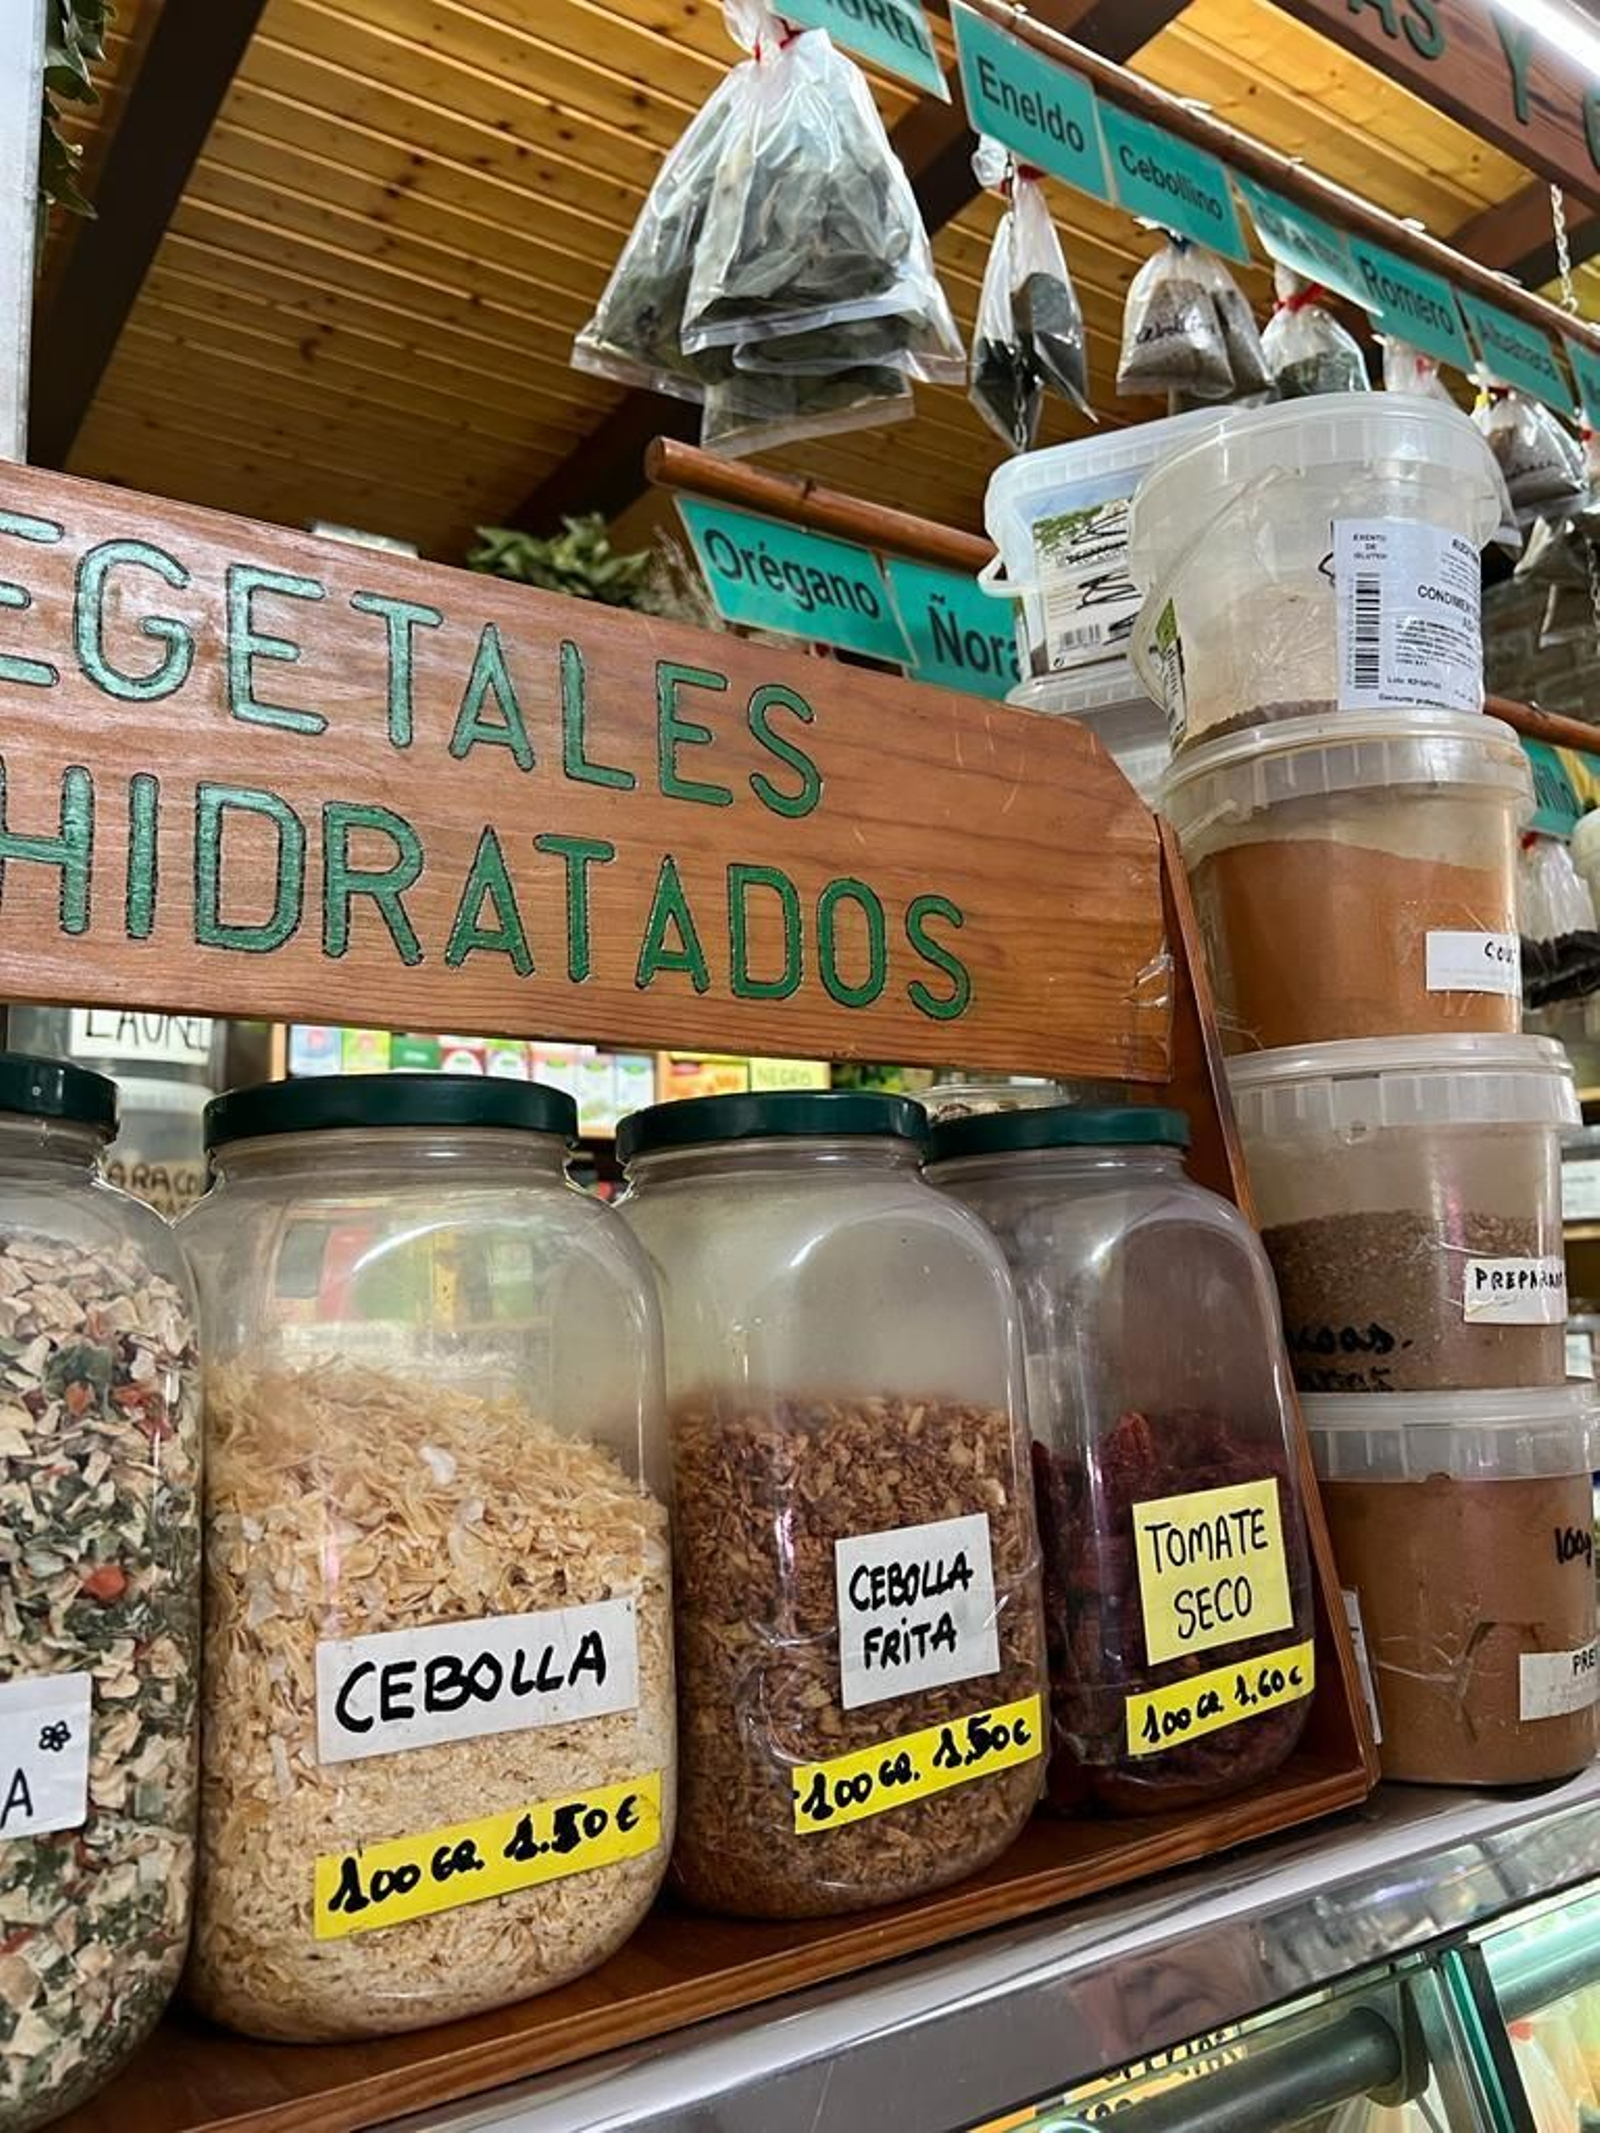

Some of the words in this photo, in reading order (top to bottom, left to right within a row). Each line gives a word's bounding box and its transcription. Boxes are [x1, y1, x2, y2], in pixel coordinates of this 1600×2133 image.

[977, 55, 1085, 153] Eneldo
[1118, 145, 1224, 221] Cebollino
[1358, 258, 1455, 336] Romero
[702, 529, 881, 620] Orégano
[1144, 1507, 1269, 1574] TOMATE
[849, 1551, 974, 1612] CEBOLLA
[1173, 1575, 1252, 1640] SECO
[334, 1629, 607, 1733] CEBOLLA
[1142, 1703, 1191, 1743] 100
[800, 1771, 873, 1821] 100
[328, 1855, 422, 1914] 100
